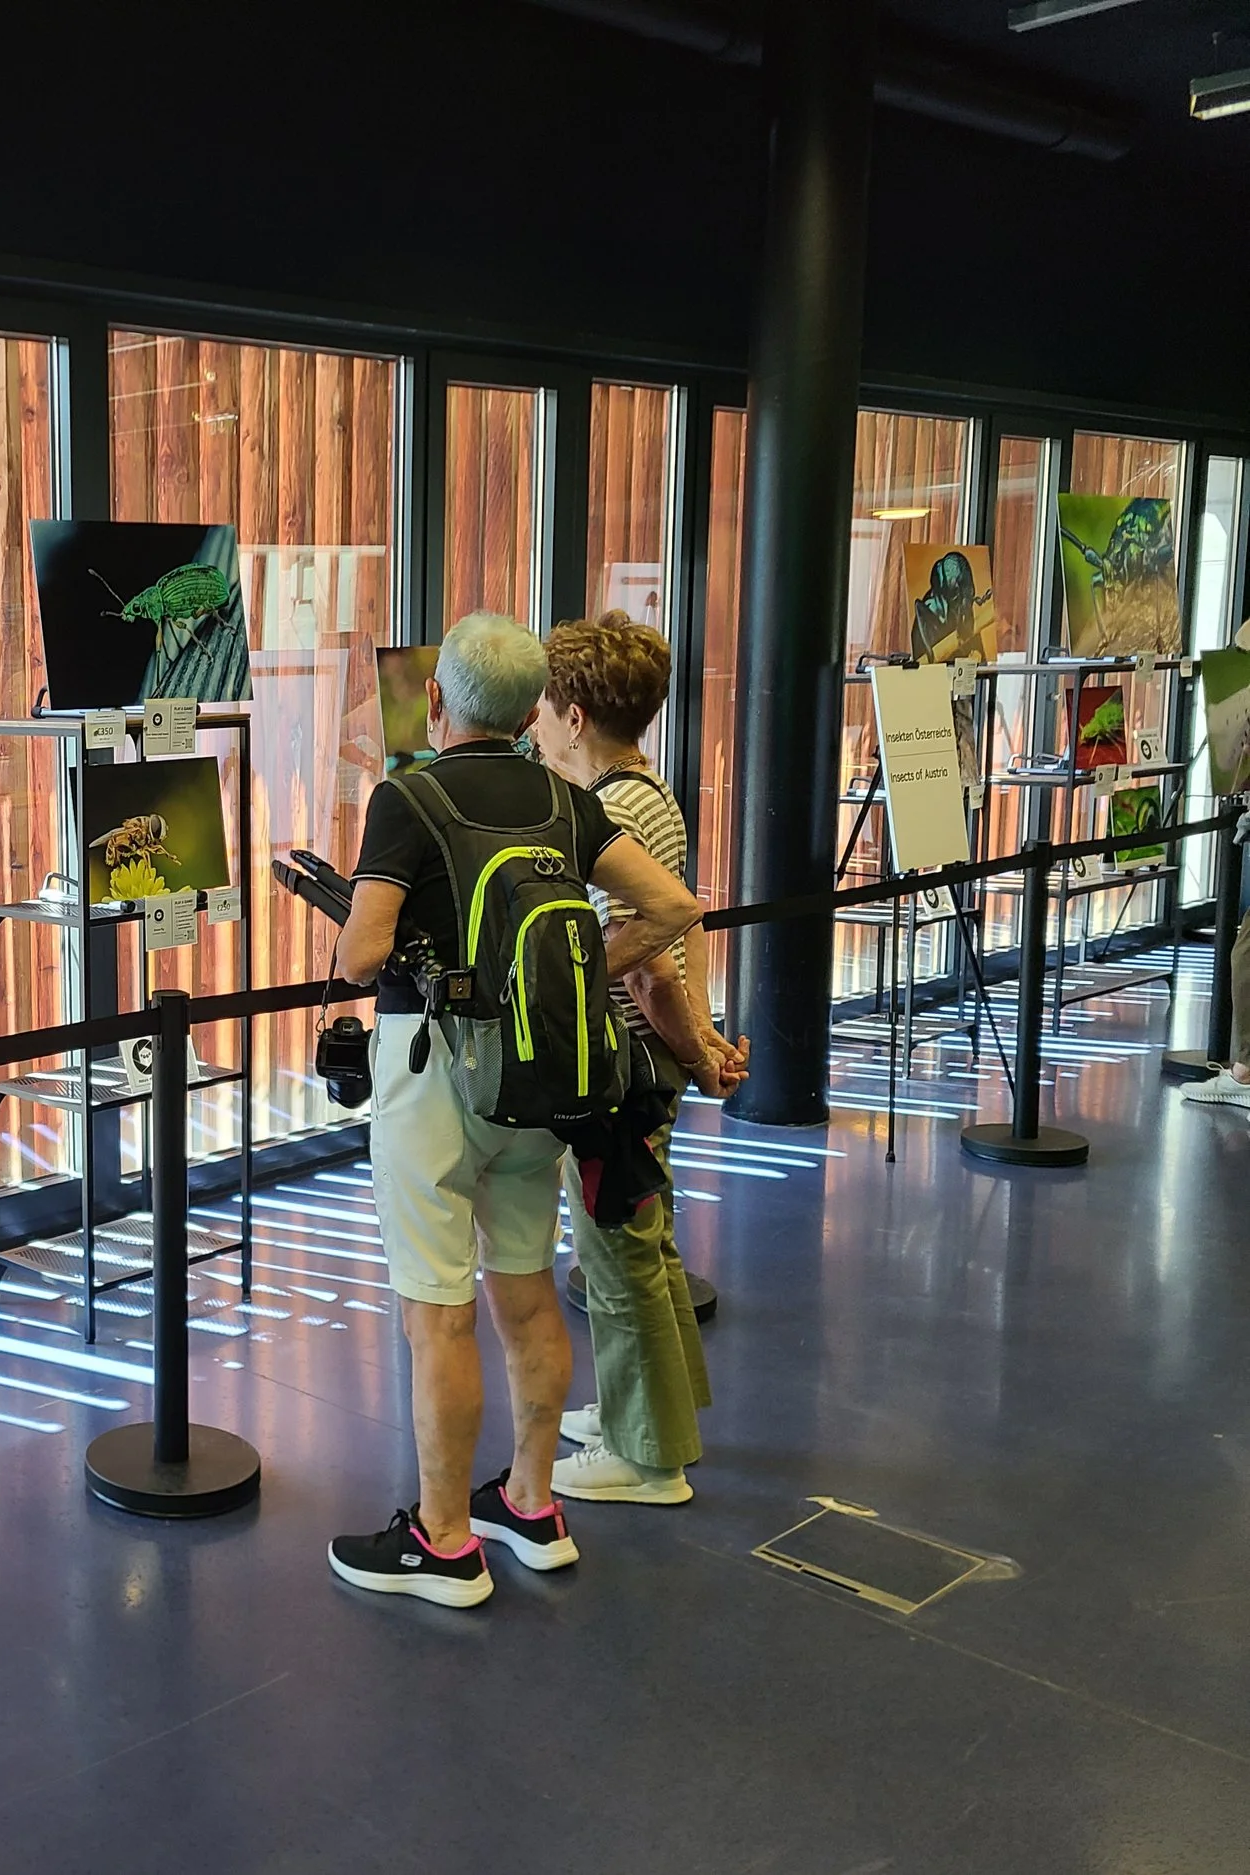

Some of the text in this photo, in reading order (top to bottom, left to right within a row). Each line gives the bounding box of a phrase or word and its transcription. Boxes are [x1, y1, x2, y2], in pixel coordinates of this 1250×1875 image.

[885, 727, 952, 743] Insekten Österreichs
[890, 767, 948, 783] Insects of Austria
